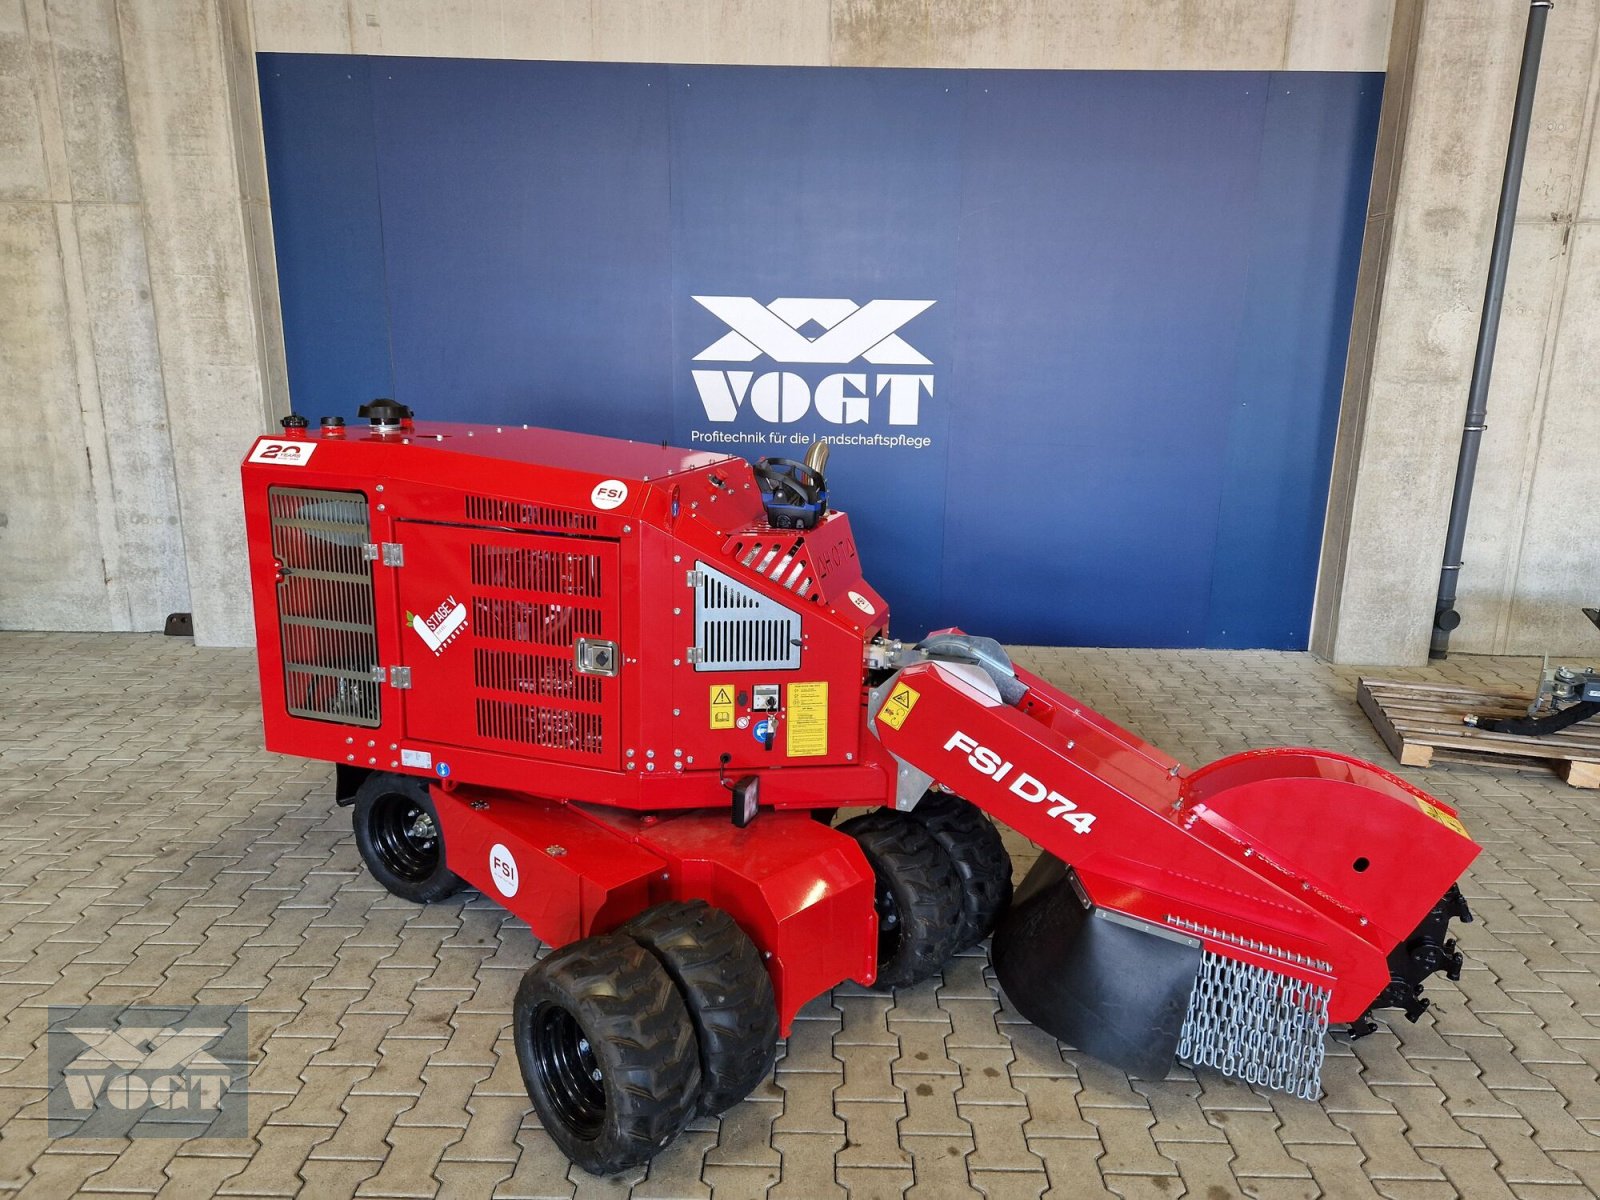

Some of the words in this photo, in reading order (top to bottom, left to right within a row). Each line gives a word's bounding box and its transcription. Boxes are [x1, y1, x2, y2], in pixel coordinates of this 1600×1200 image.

[691, 370, 934, 425] VOGT
[691, 430, 767, 443] Profitechnik
[769, 432, 787, 444] für
[790, 433, 810, 444] die
[597, 487, 624, 499] FSI
[426, 601, 453, 630] STAGE
[446, 594, 457, 607] V
[434, 620, 469, 657] APPROVED
[943, 730, 1014, 782] FSI
[1008, 772, 1097, 835] D74
[493, 856, 514, 880] FSI
